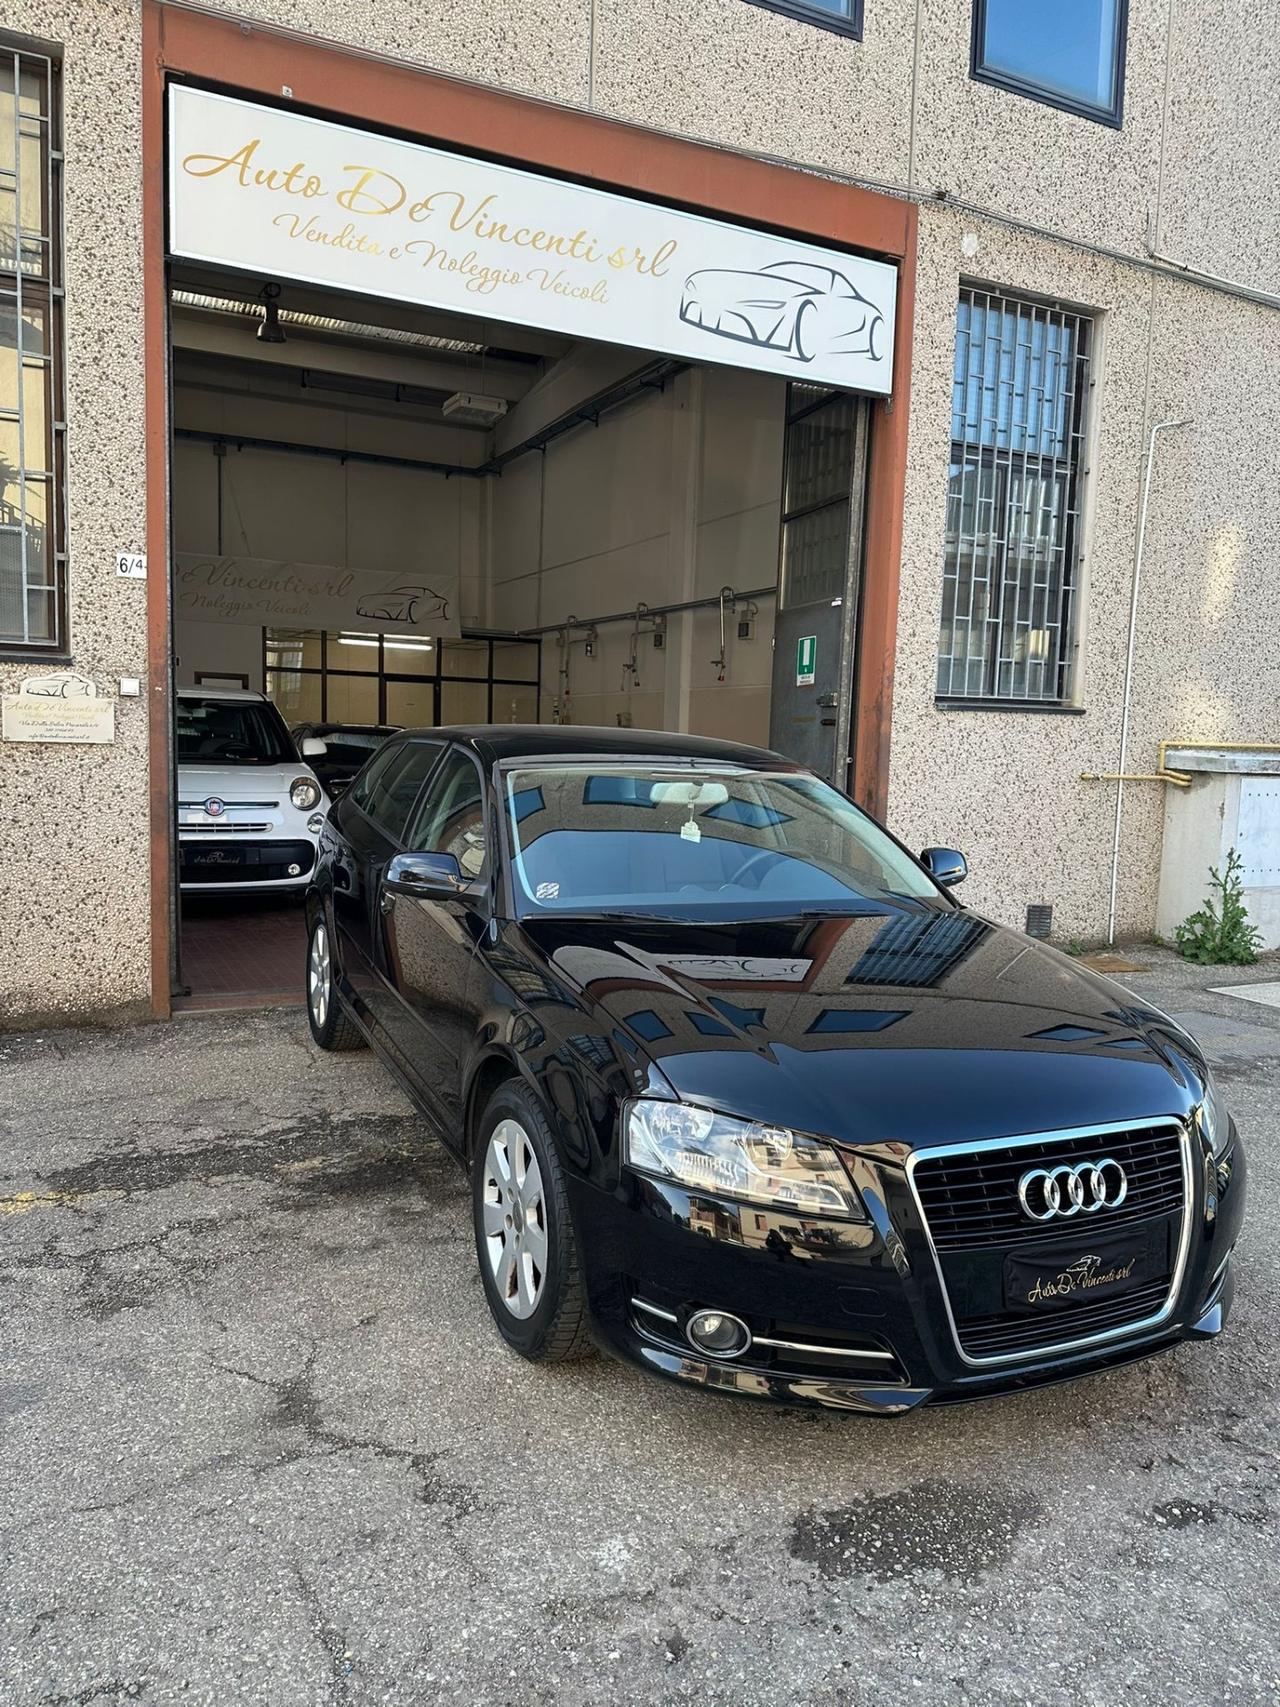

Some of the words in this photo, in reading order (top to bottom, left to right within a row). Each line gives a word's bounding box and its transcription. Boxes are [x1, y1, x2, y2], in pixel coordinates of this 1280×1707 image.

[182, 139, 329, 198] Auto
[336, 165, 432, 222] De
[423, 192, 602, 262] Vincenti
[607, 240, 678, 277] srl
[273, 213, 384, 254] Vendita
[389, 245, 402, 259] e
[405, 240, 523, 295] Noleggio
[527, 269, 609, 304] Veicoli
[119, 557, 143, 574] 6/4
[189, 561, 305, 594] Vincenti
[1028, 1277, 1057, 1302] Auto
[1077, 1267, 1115, 1289] Vincenti
